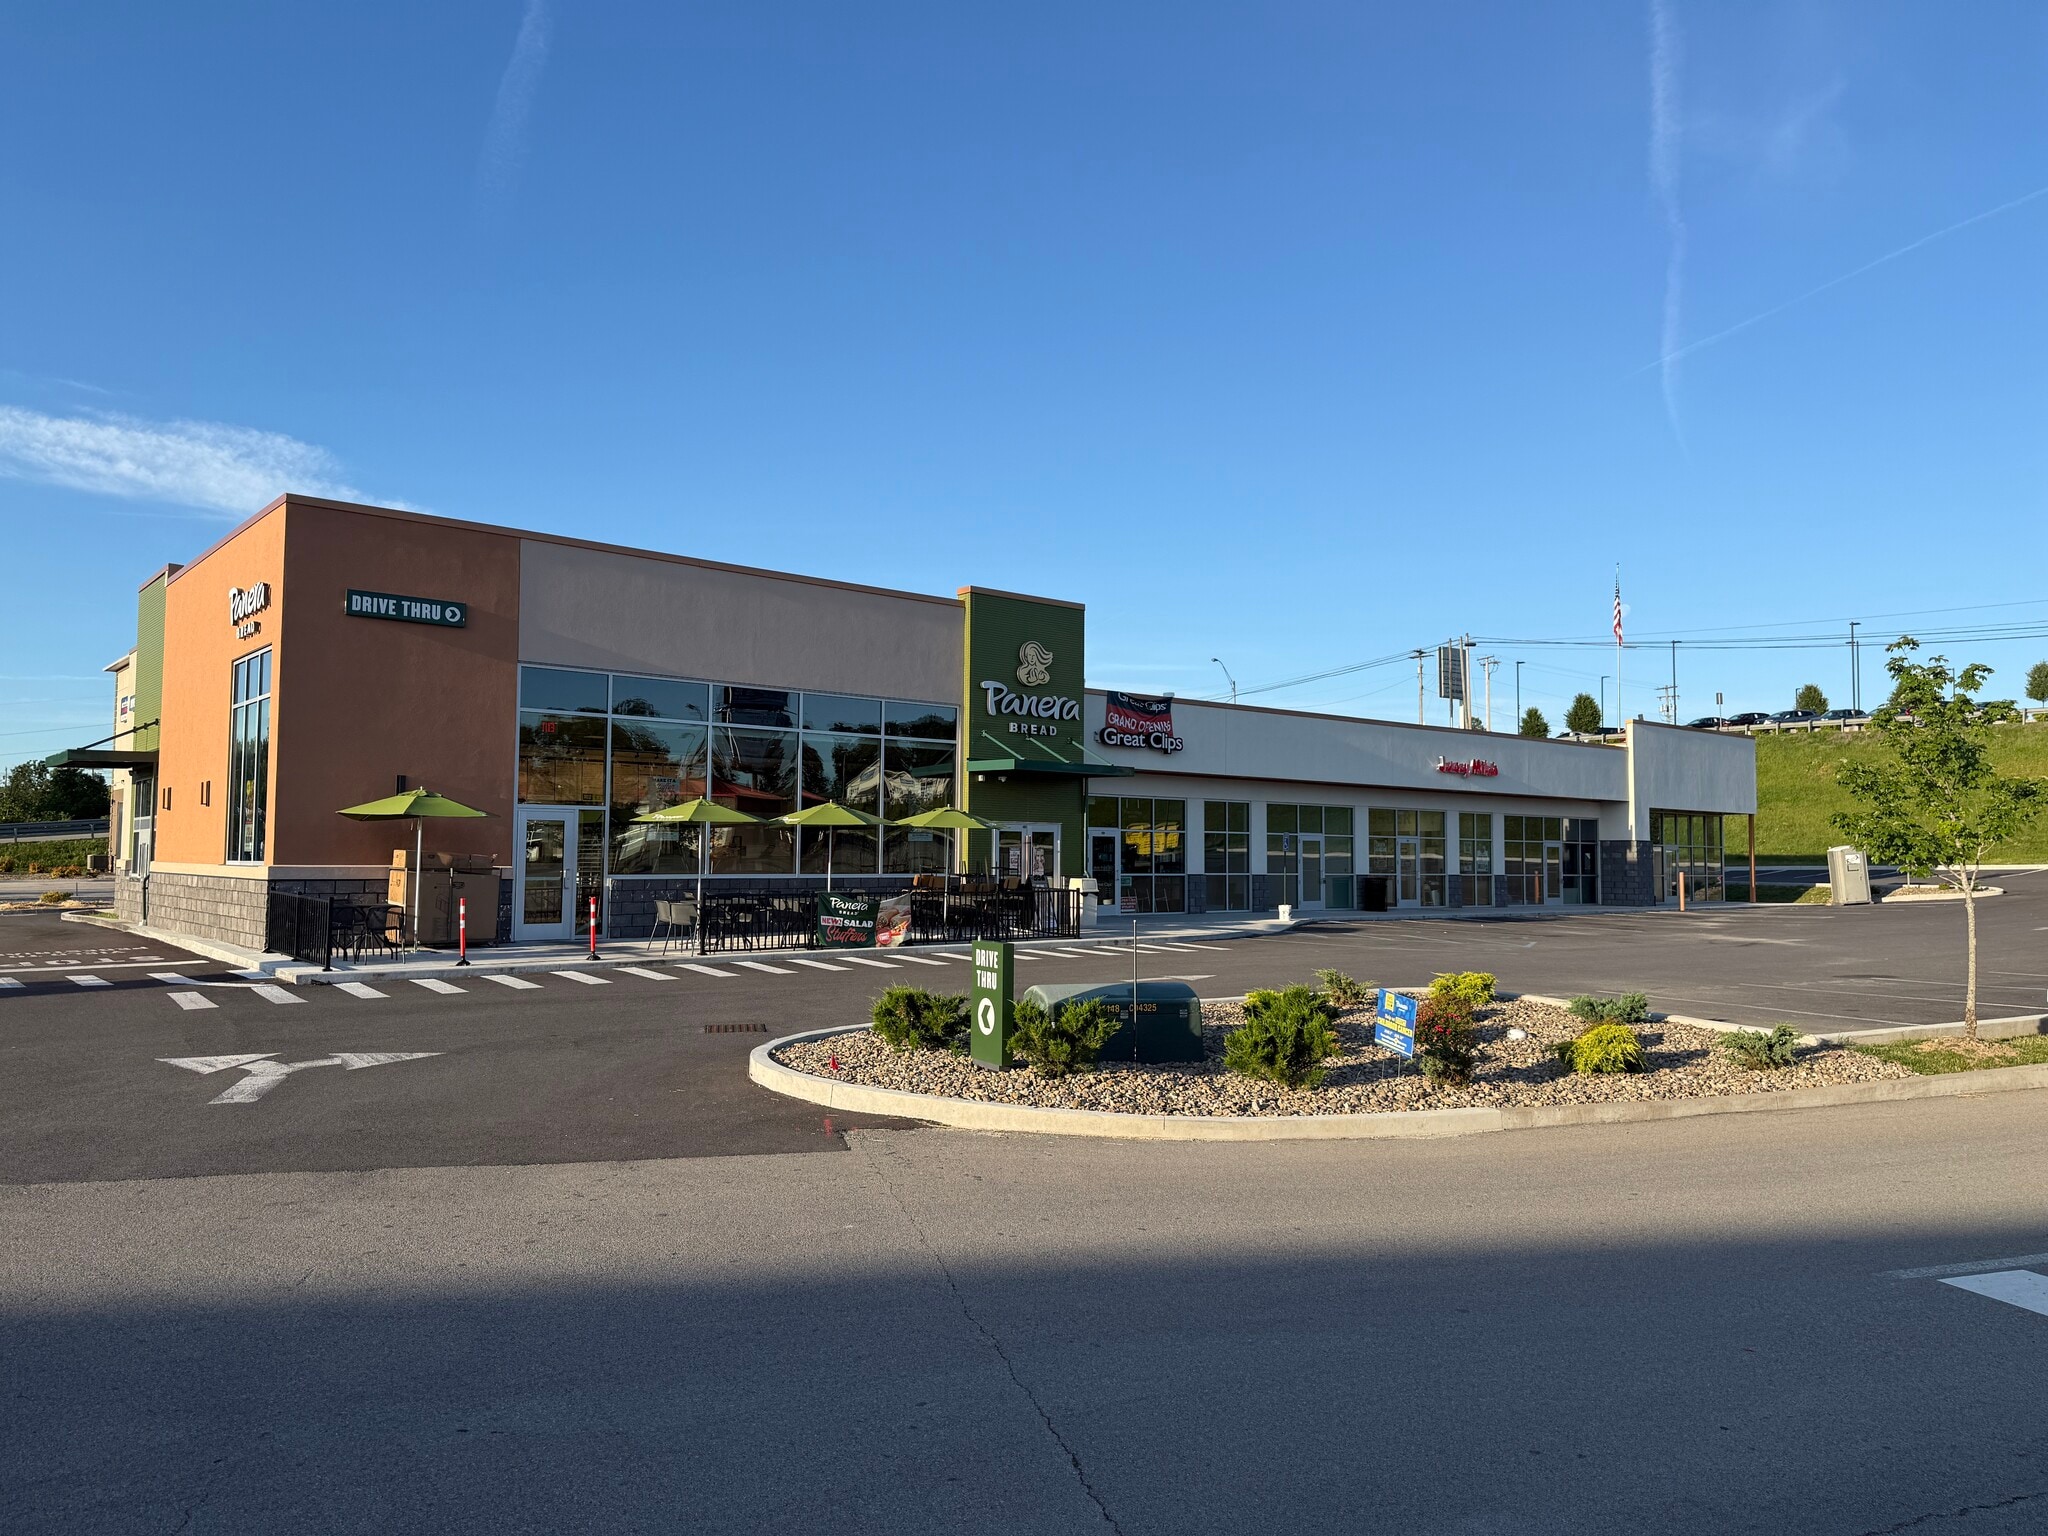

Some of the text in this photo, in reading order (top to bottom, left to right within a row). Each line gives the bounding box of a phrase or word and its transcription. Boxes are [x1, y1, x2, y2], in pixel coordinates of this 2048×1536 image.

[229, 582, 267, 626] Panera
[351, 594, 441, 621] DRIVE THRU
[979, 681, 1080, 721] Panera
[1008, 722, 1057, 736] BREAD
[1107, 712, 1137, 730] GRAND
[1103, 727, 1183, 754] Great Clips
[829, 897, 868, 911] Panera
[844, 919, 873, 928] SALAD
[826, 925, 867, 943] Stuffers
[975, 949, 999, 969] DRIVE
[976, 969, 998, 990] THRU
